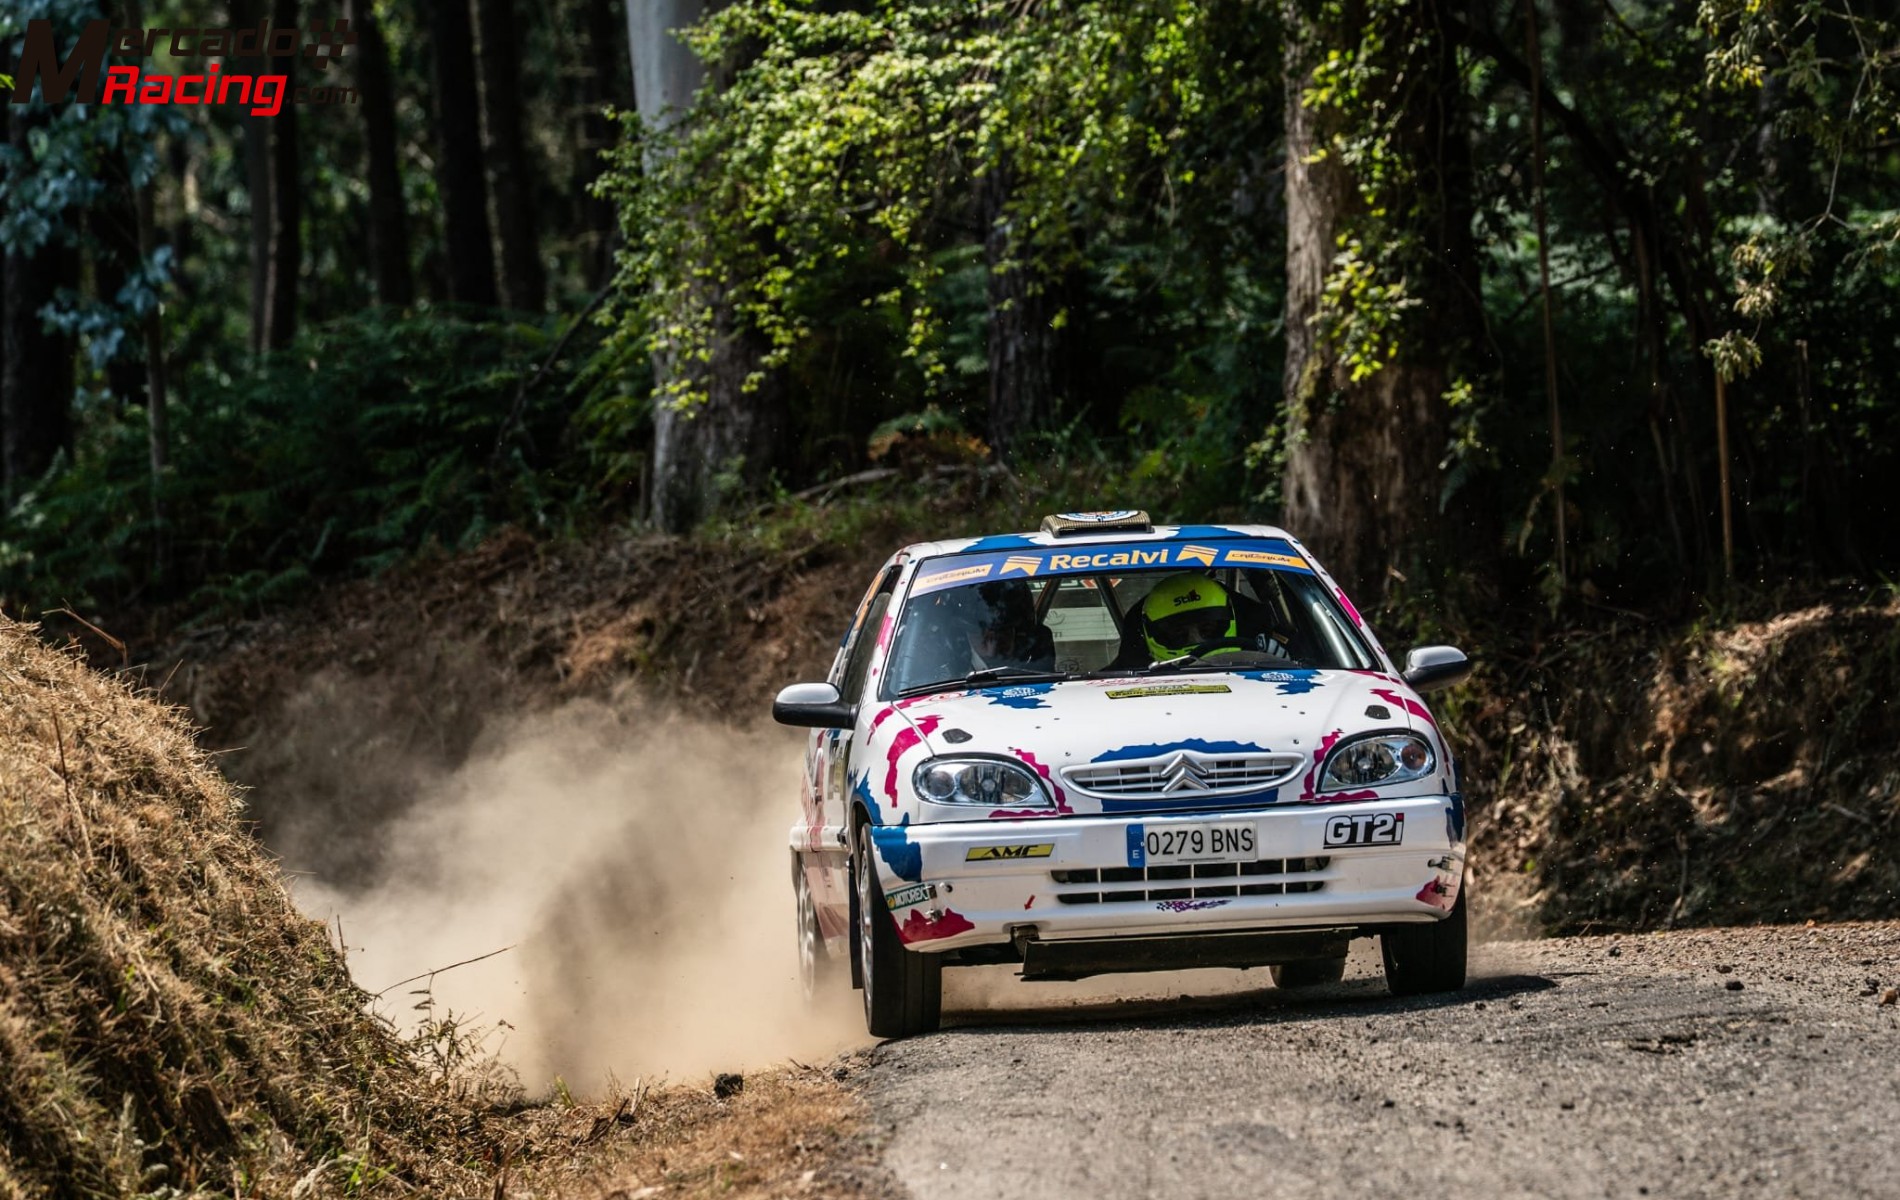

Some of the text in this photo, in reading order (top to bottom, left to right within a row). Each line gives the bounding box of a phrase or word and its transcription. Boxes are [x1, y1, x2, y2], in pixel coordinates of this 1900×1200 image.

[1049, 548, 1169, 571] Recalvi
[1146, 827, 1254, 856] 0279 BNS
[1323, 812, 1405, 846] GT2i
[1131, 849, 1140, 859] E
